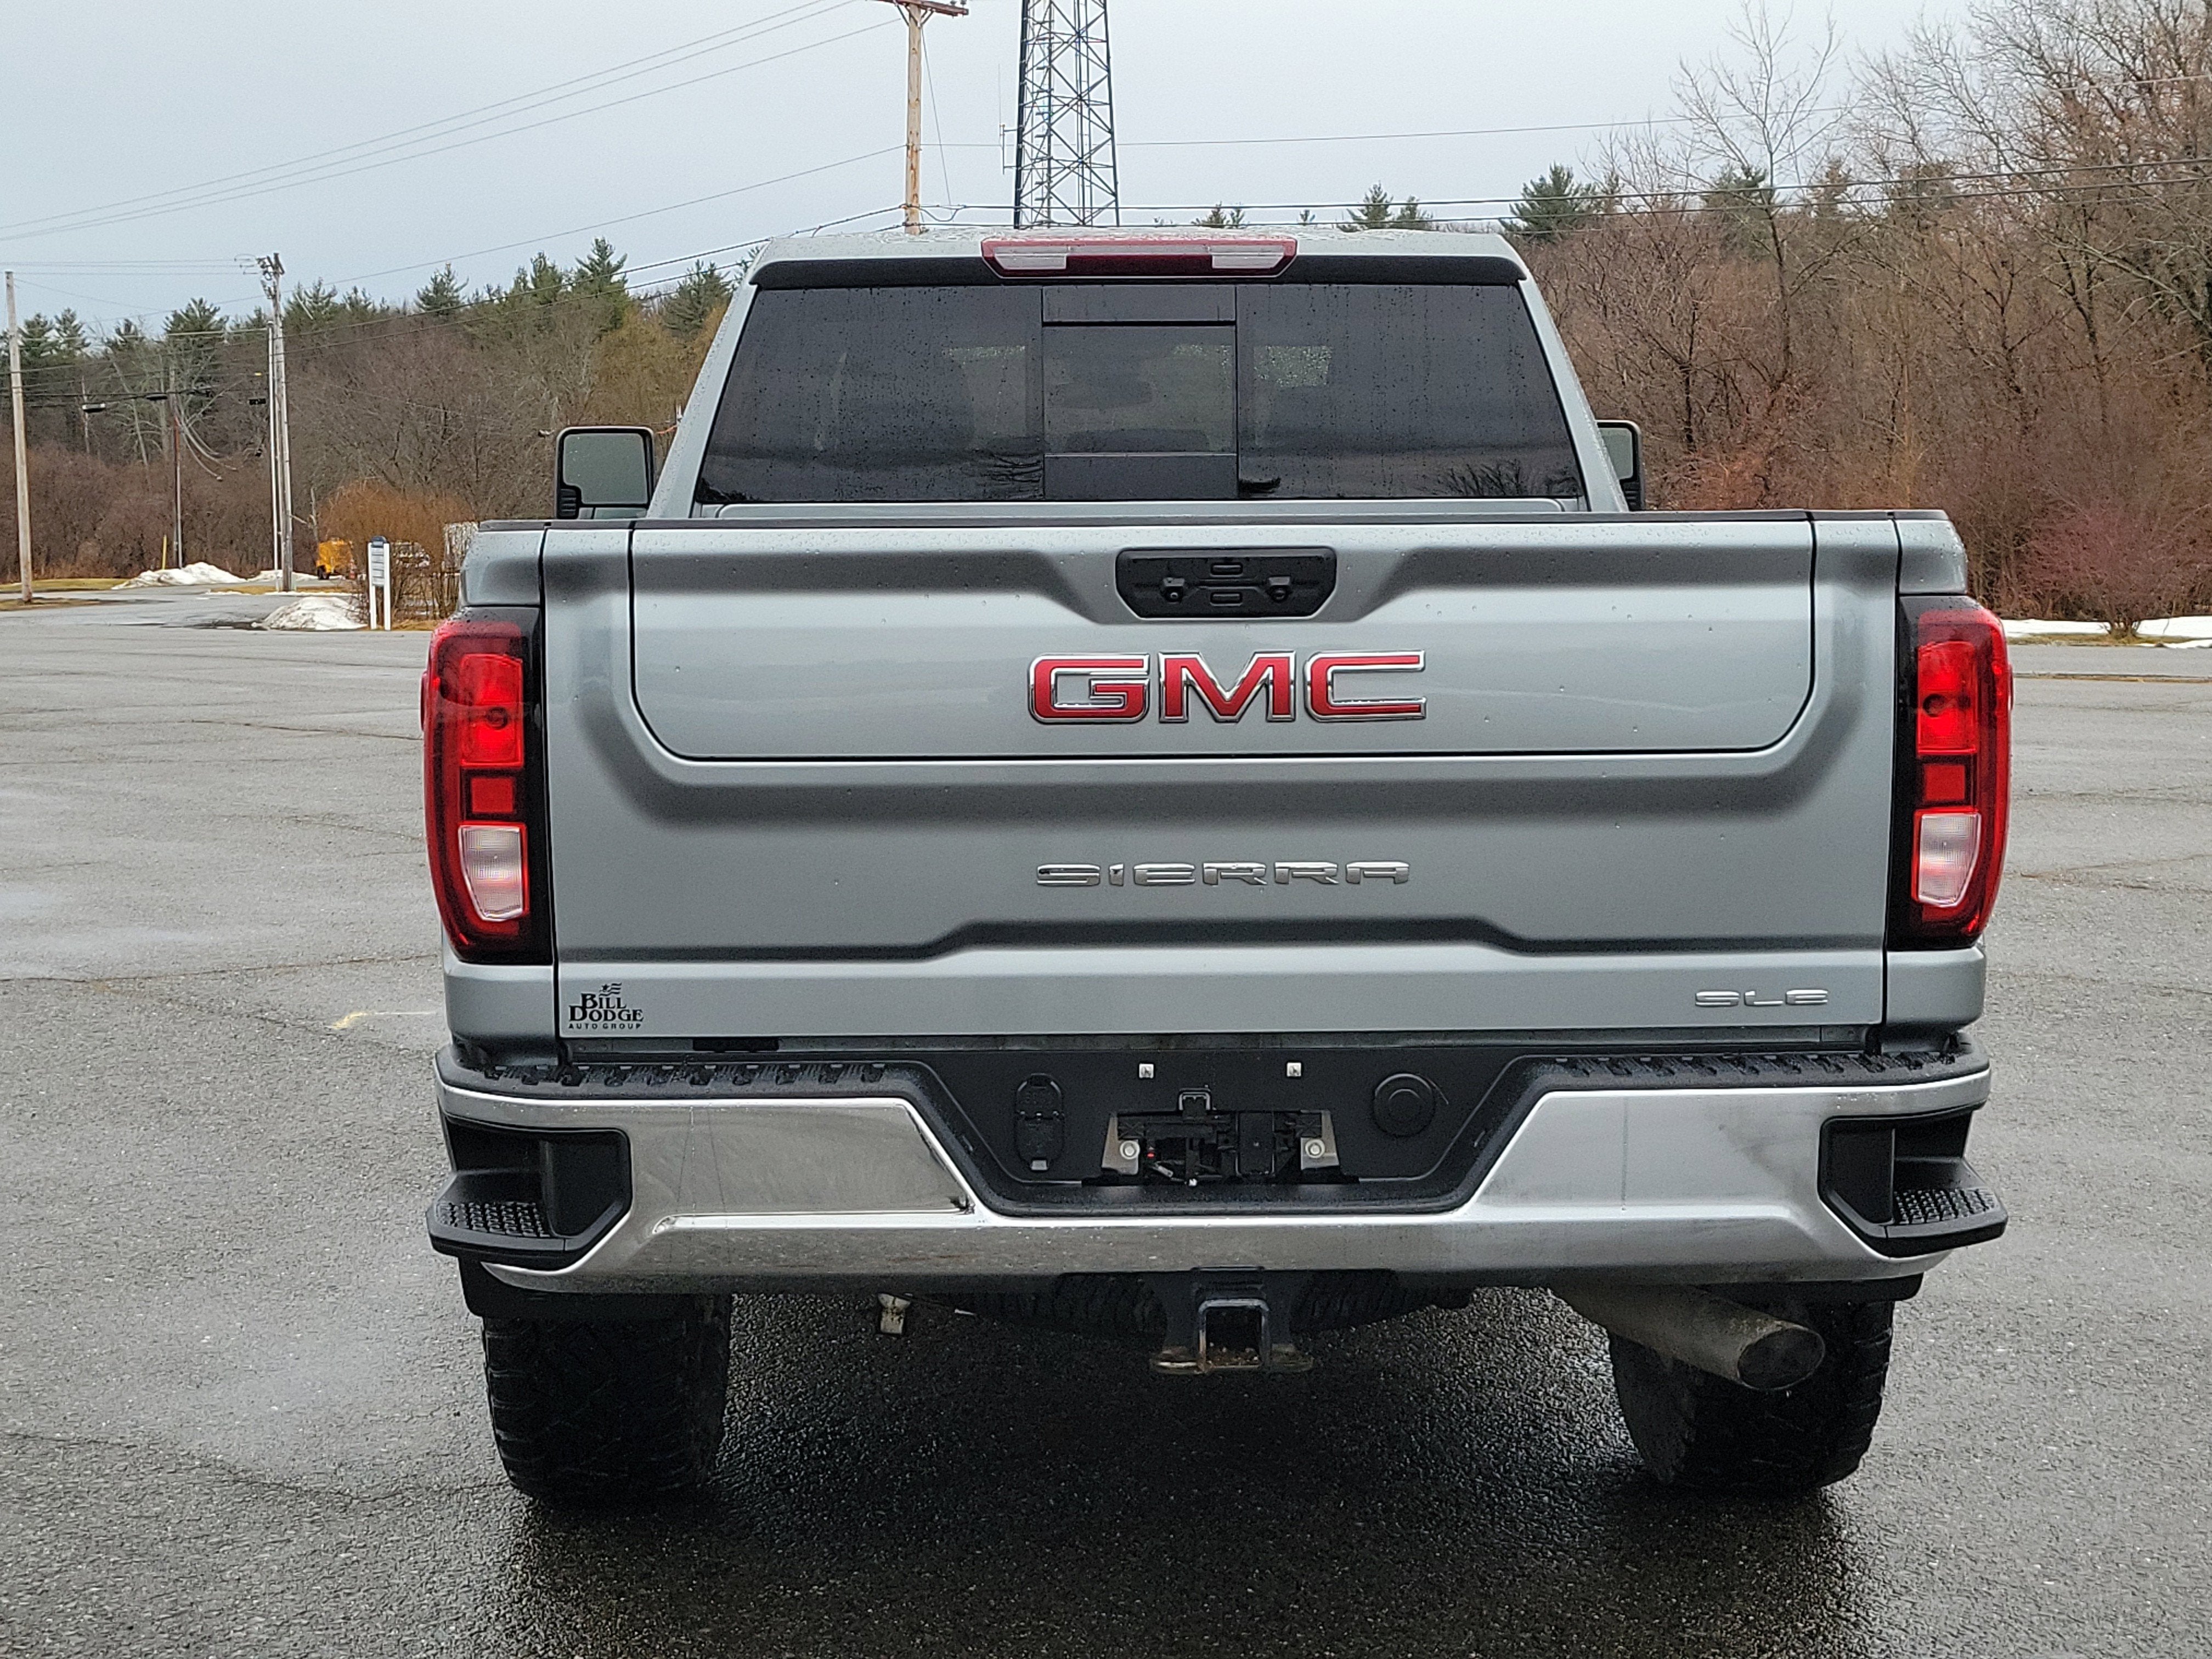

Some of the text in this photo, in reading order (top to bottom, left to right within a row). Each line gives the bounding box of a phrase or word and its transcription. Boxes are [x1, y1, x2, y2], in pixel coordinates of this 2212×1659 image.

[1028, 650, 1426, 723] GMC
[1036, 861, 1410, 887] SIERRA
[581, 992, 627, 1009] BILL
[1695, 989, 1829, 1007] SLE
[569, 1005, 644, 1022] DODGE
